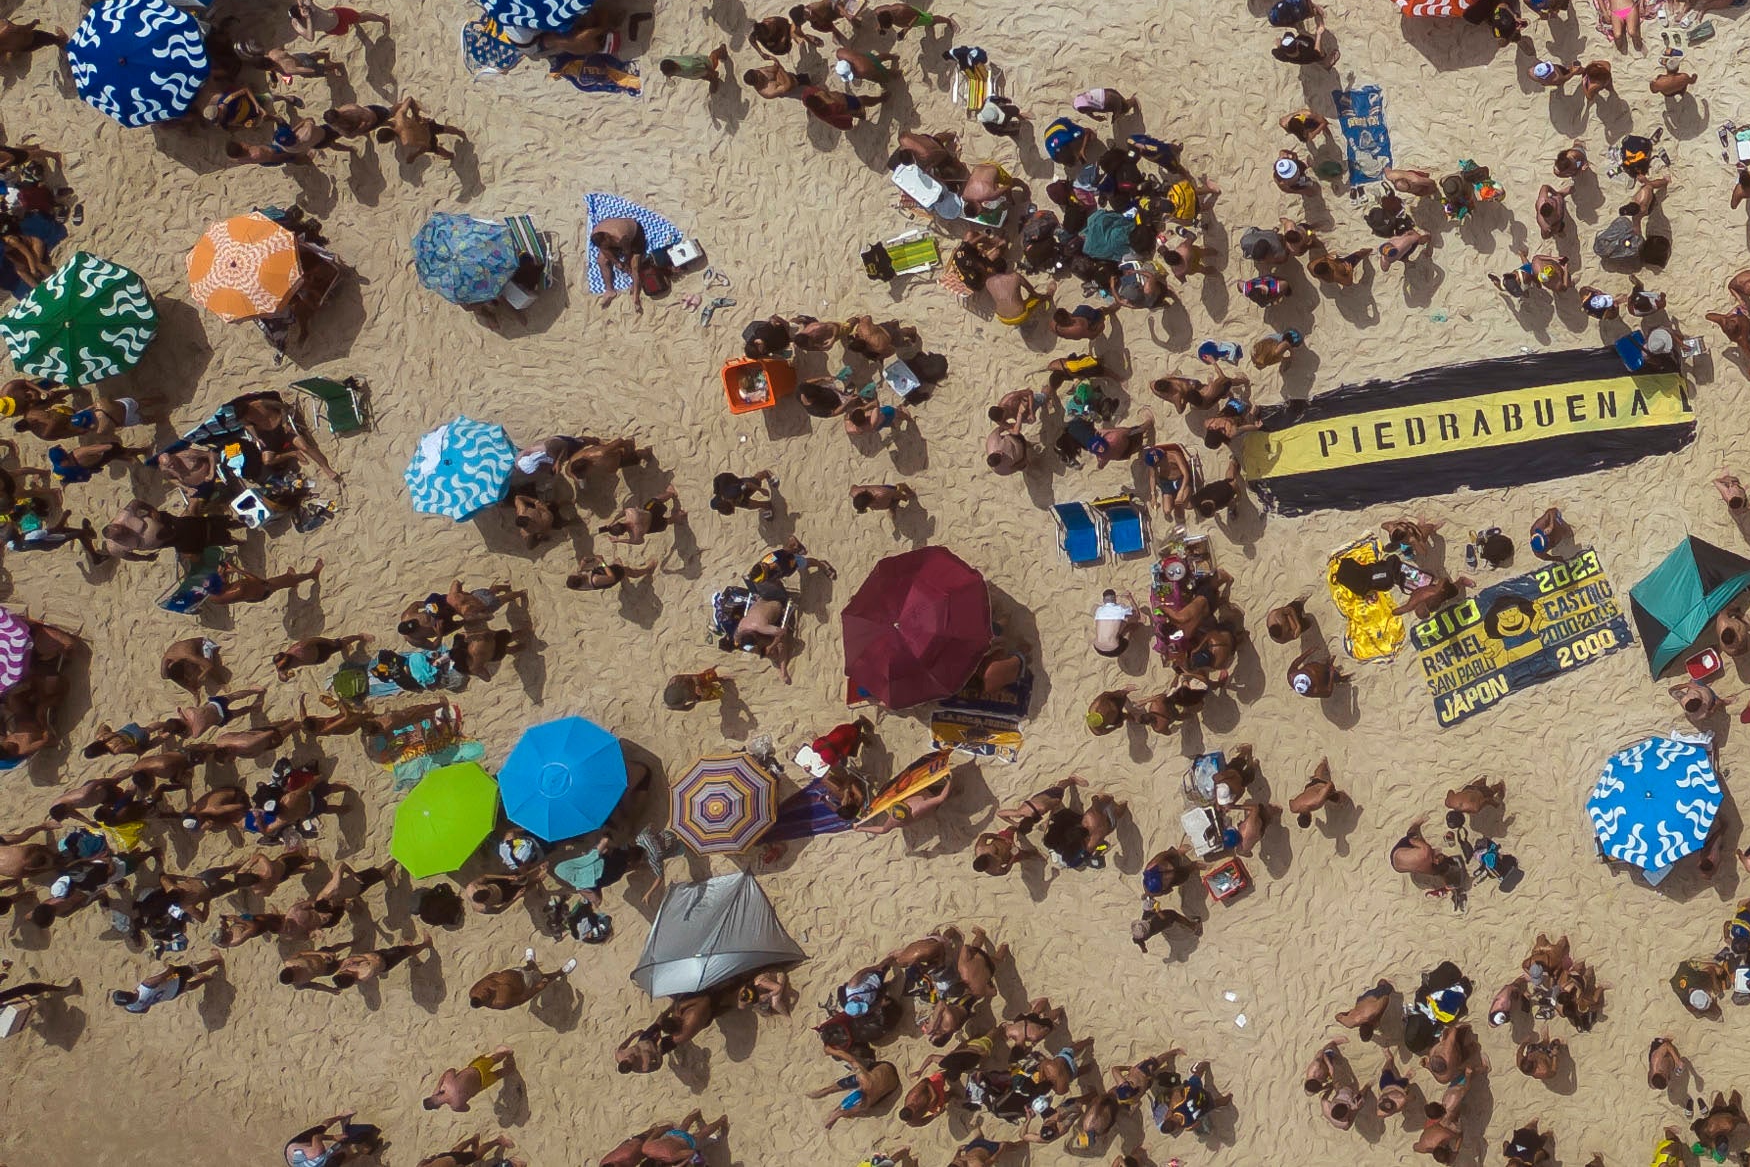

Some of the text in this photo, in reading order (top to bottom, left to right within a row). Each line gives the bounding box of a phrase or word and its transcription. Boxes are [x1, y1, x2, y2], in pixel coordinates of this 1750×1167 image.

[1318, 390, 1650, 458] PIEDRABUENA
[1535, 550, 1600, 593] 2023
[1415, 599, 1481, 646] RIO
[1422, 634, 1485, 677] RAFAEL
[1556, 628, 1616, 670] 2000
[1427, 657, 1498, 697] SAN PABLO
